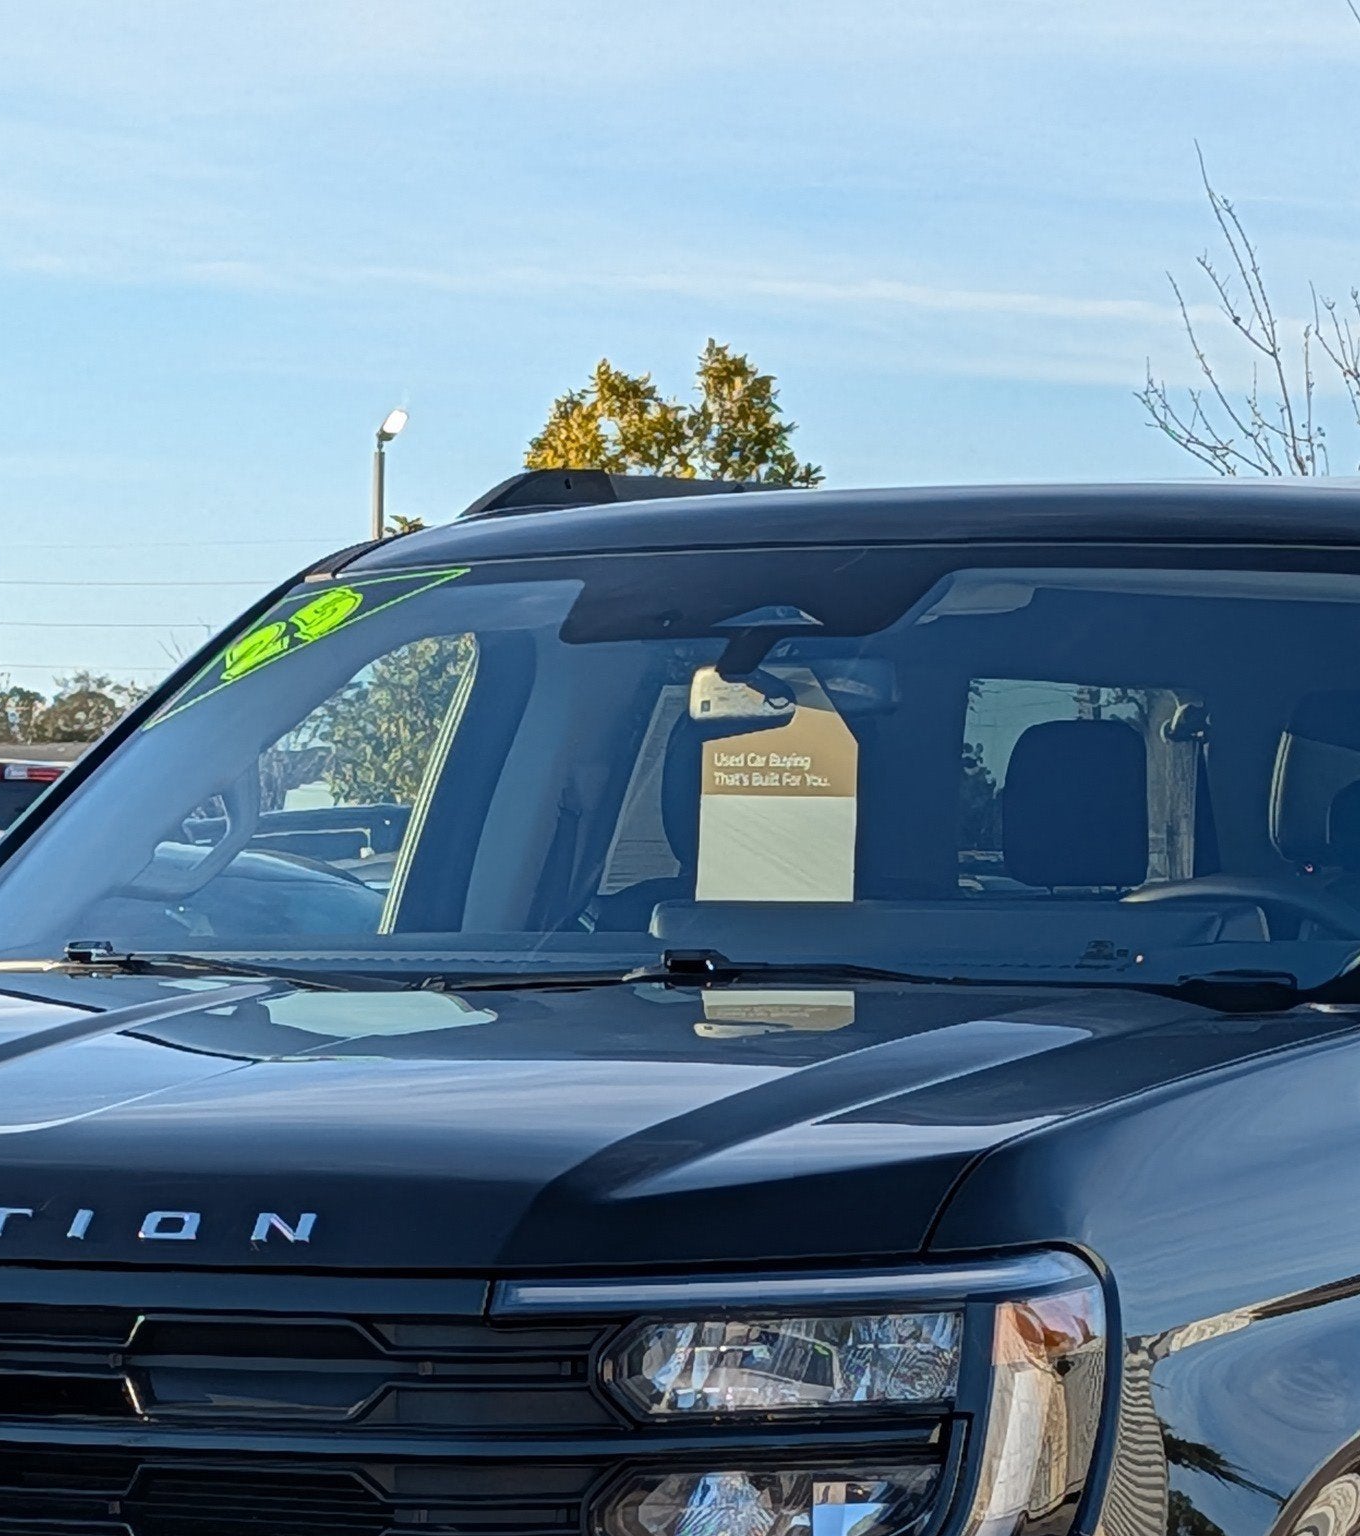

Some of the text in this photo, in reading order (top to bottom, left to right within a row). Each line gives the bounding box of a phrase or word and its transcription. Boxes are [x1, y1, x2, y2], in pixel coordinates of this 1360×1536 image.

[714, 753, 811, 770] Used Car Buying
[714, 772, 749, 786] That's
[752, 772, 780, 786] Built
[782, 773, 802, 786] For
